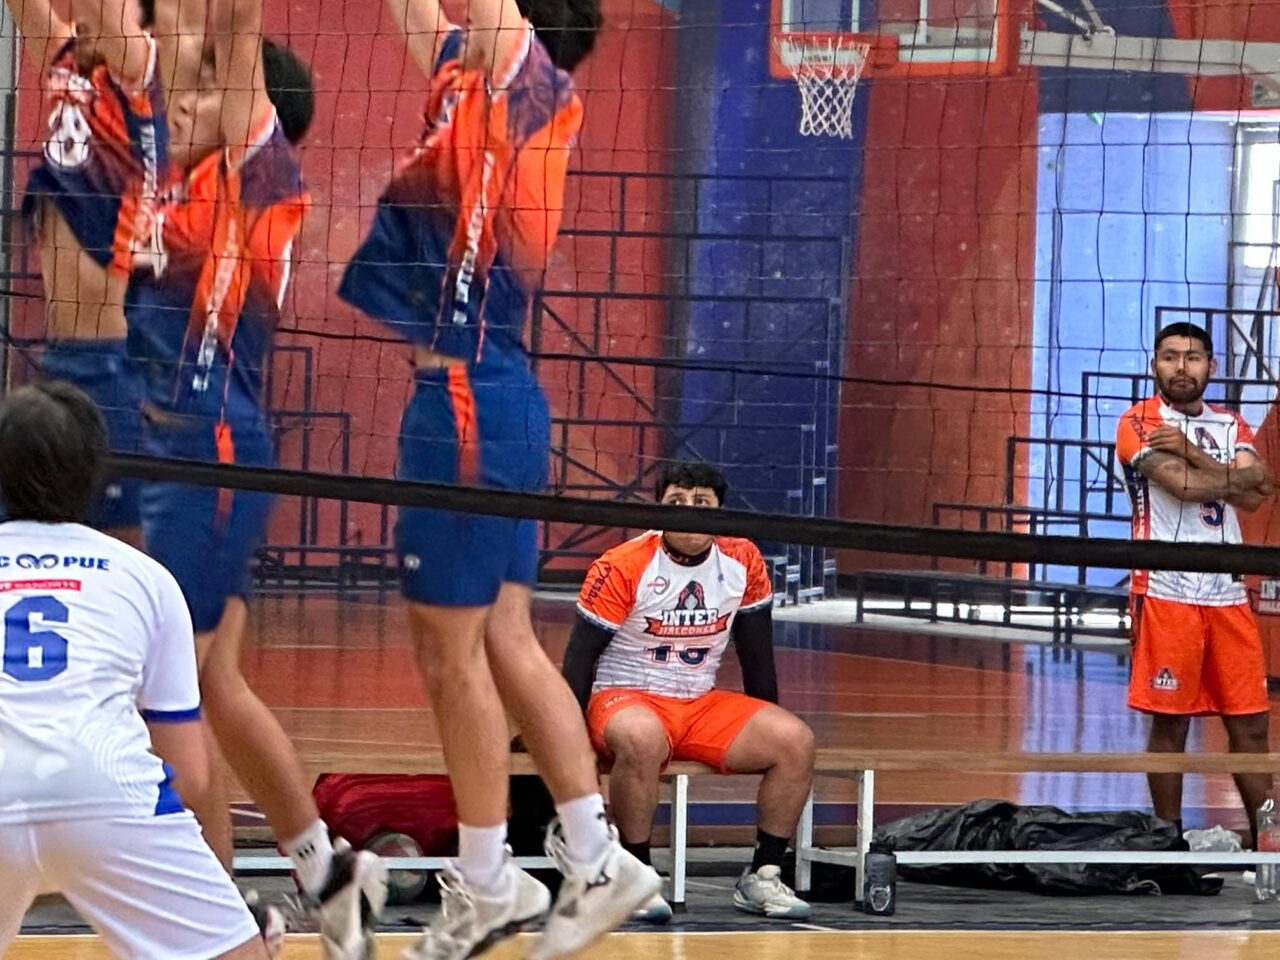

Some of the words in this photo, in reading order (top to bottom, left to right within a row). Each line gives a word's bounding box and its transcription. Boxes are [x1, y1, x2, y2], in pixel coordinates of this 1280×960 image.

[63, 556, 111, 571] PUE
[661, 608, 718, 626] INTER
[3, 595, 69, 682] 6
